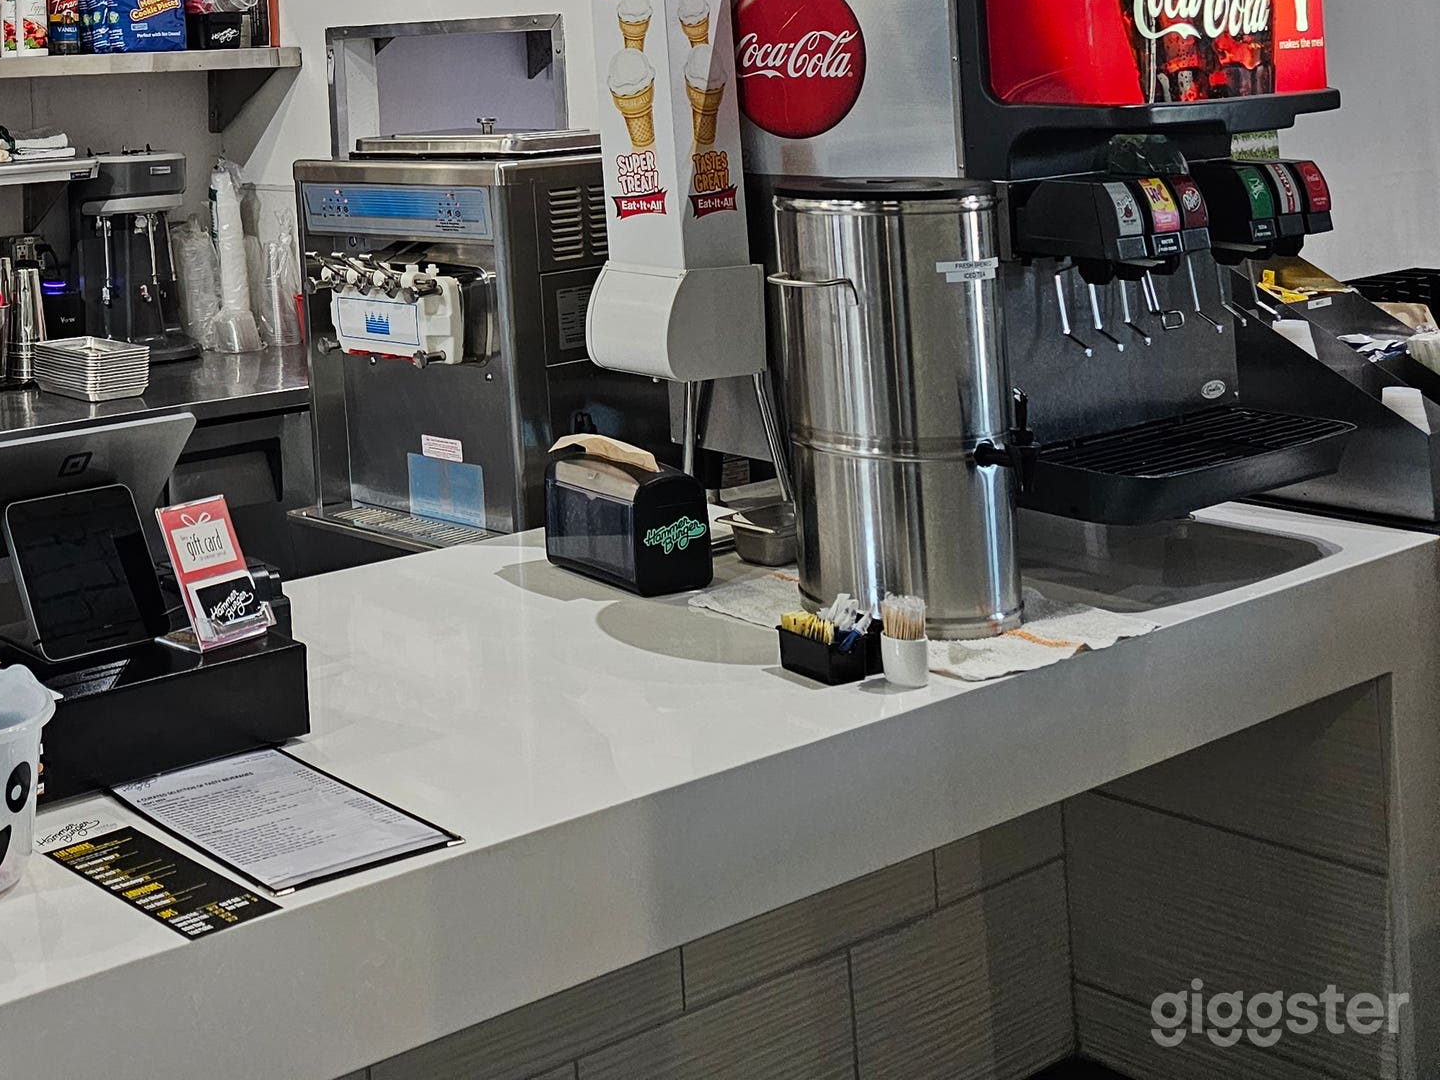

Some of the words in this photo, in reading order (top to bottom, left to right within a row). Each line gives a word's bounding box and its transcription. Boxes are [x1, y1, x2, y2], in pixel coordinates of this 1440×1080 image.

[132, 4, 158, 18] Cookie
[158, 0, 179, 12] Pieces
[736, 30, 858, 79] Coca-Cola
[616, 150, 656, 175] SUPER
[691, 151, 729, 174] TASTES
[617, 169, 659, 195] TREAT!
[694, 169, 729, 193] GREAT!
[186, 533, 205, 561] gift
[204, 528, 223, 553] card
[644, 516, 690, 547] Hammer
[661, 520, 706, 554] Burger
[210, 589, 239, 620] Hammer
[225, 591, 254, 621] Burger
